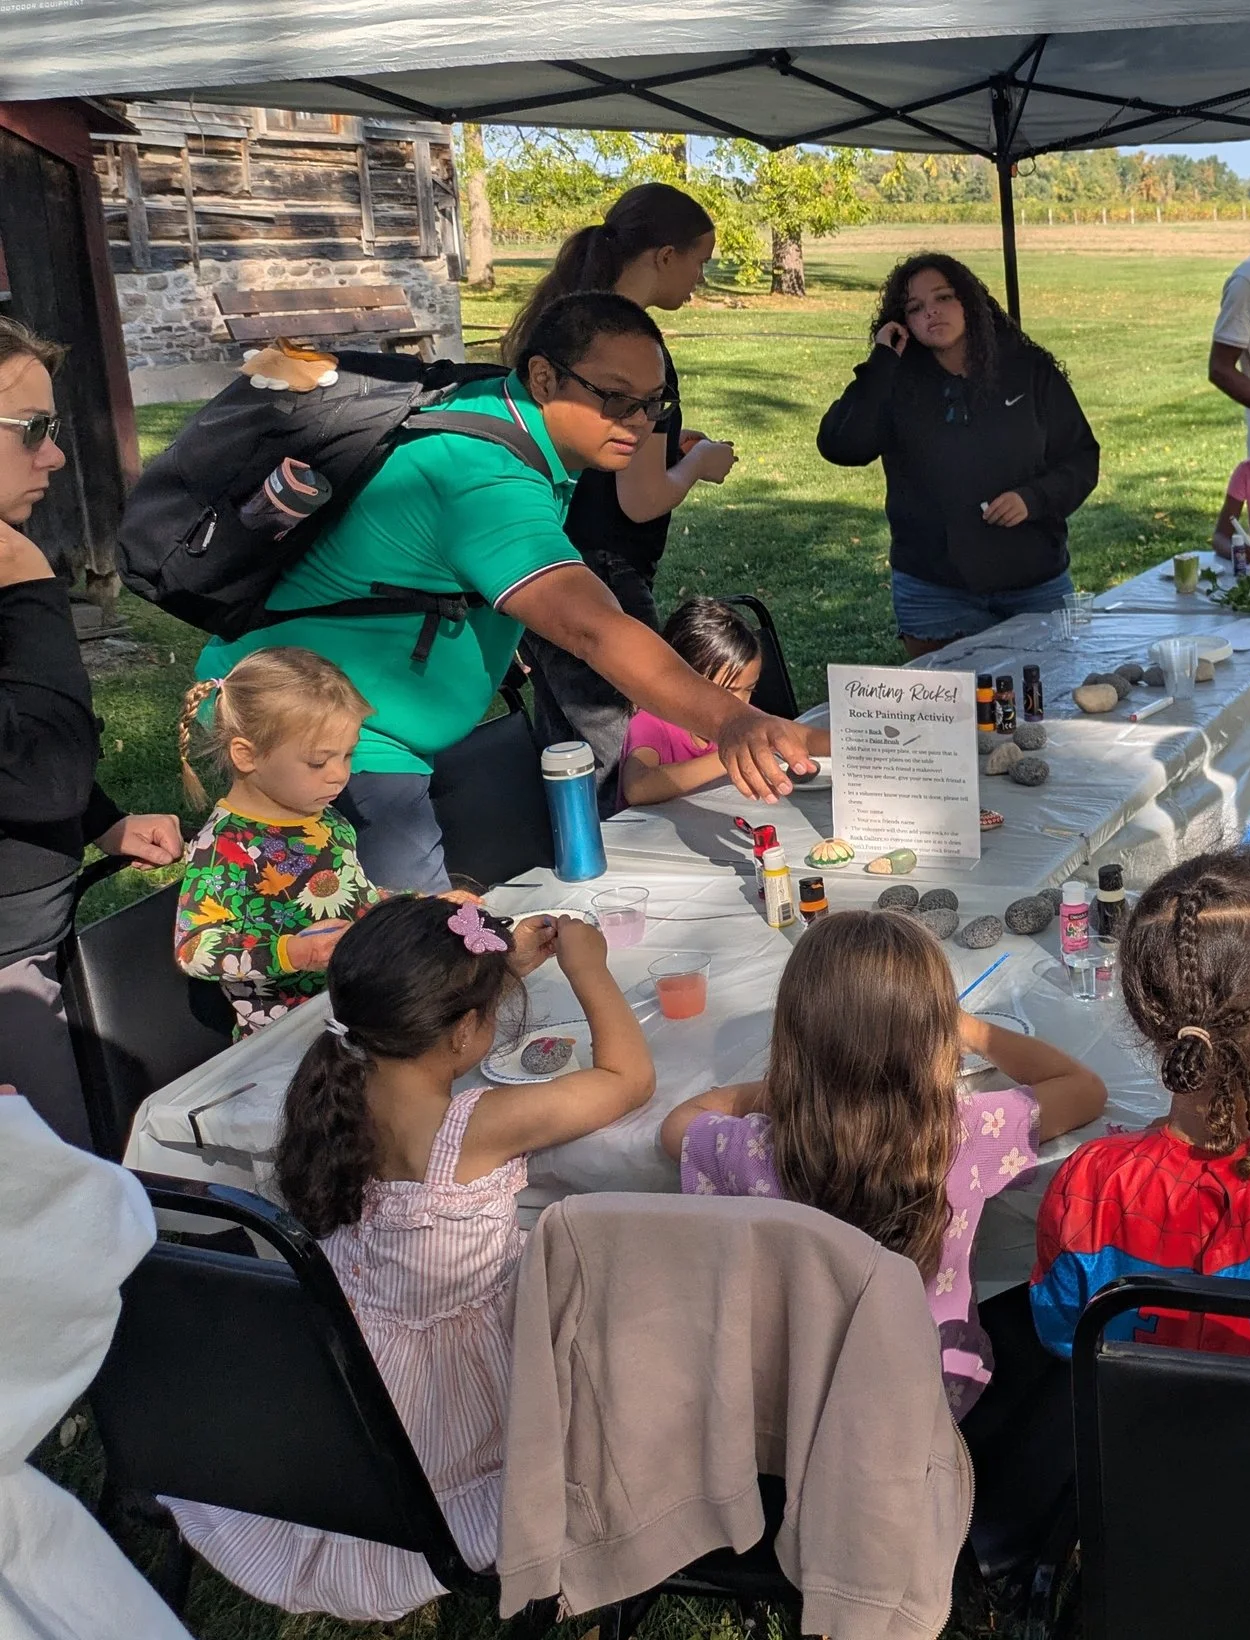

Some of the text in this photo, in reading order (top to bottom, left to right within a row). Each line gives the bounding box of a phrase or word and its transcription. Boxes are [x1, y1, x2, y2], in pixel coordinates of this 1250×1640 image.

[845, 681, 958, 703] Painting Rocks!
[849, 709, 954, 724] Rock Painting Activity
